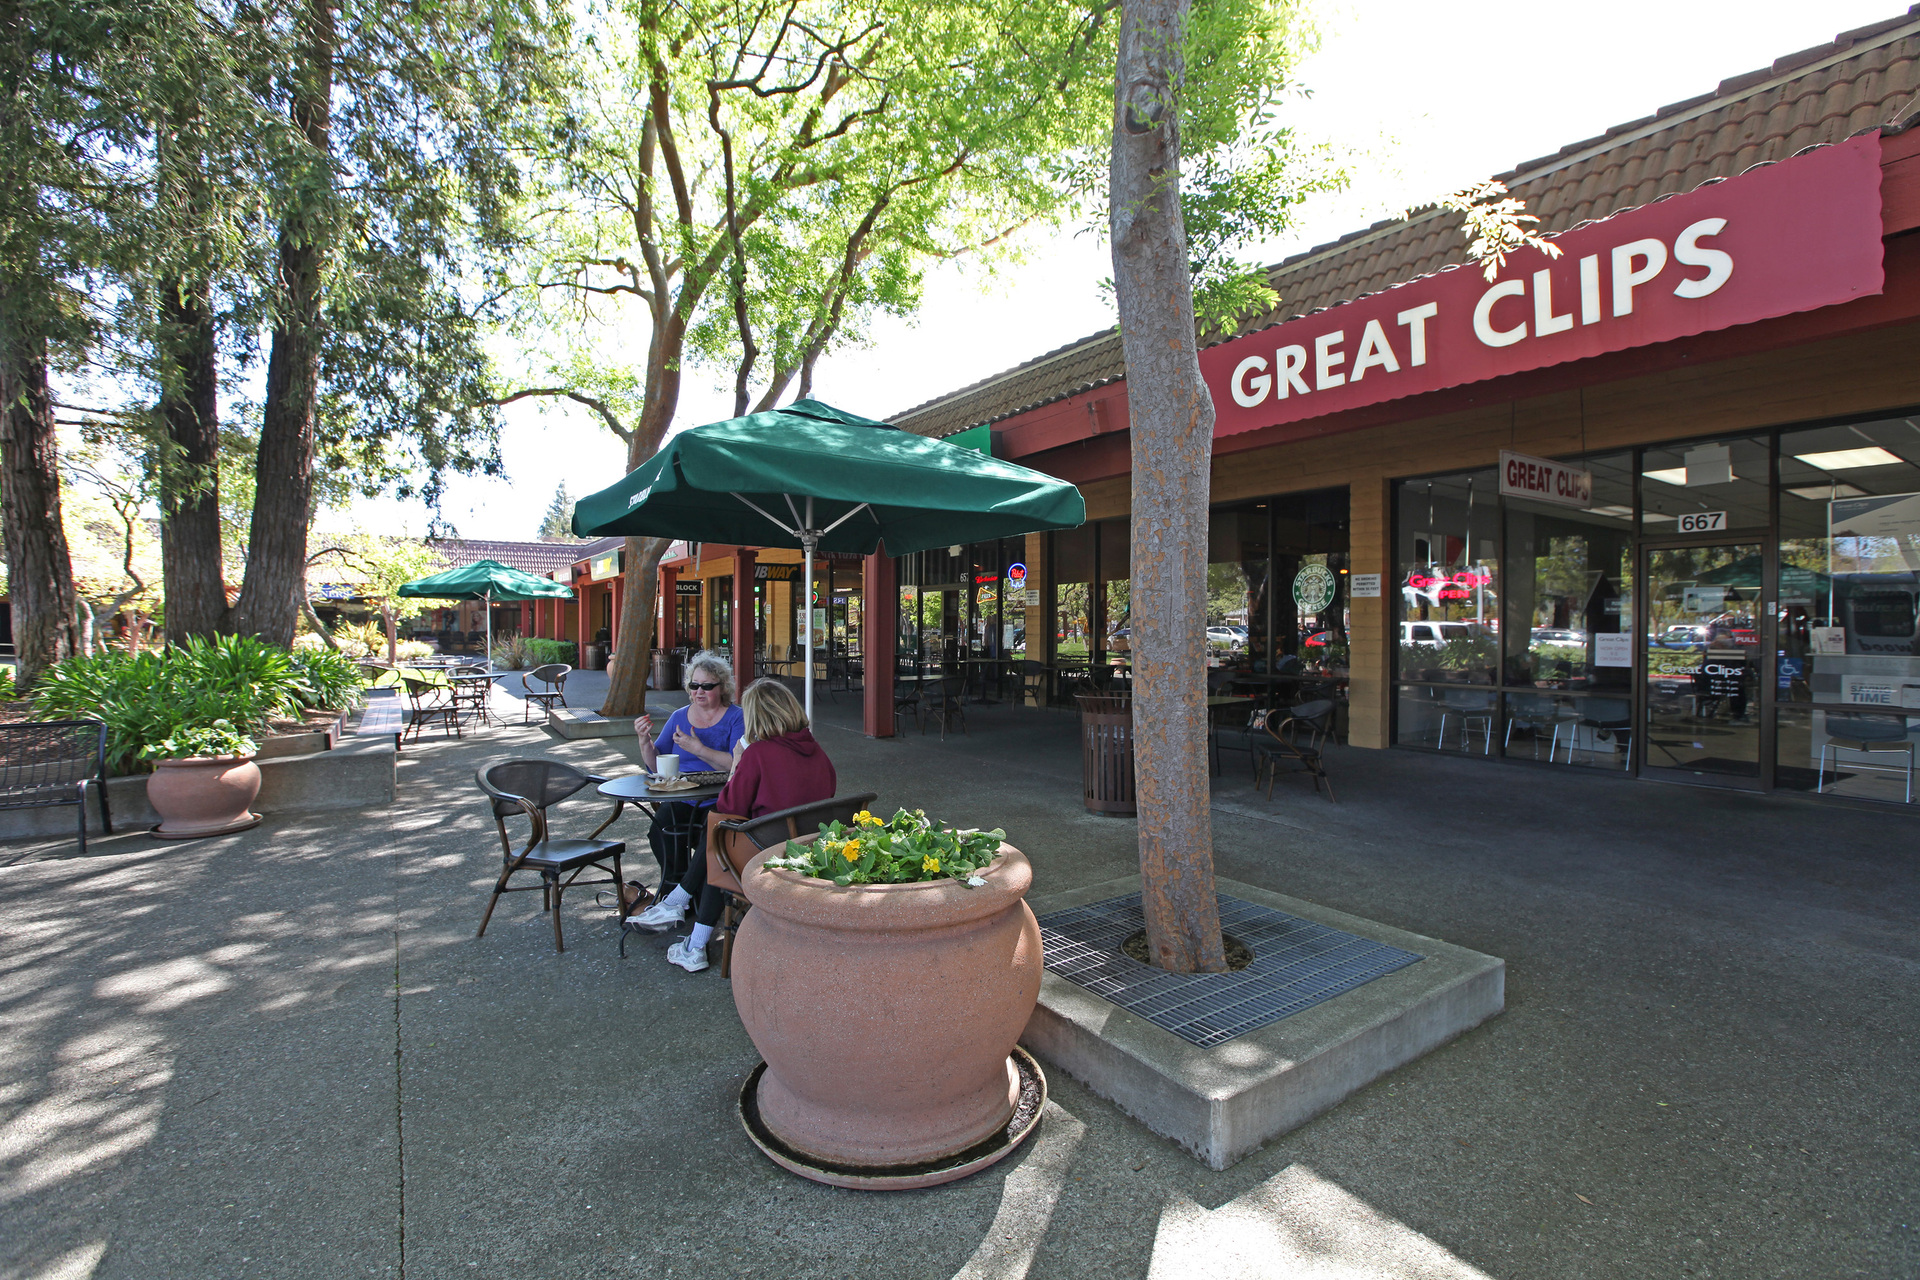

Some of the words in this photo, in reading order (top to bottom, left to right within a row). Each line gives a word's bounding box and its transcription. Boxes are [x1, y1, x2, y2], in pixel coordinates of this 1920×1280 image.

[1230, 302, 1438, 408] GREAT
[1473, 217, 1735, 348] CLIPS
[1507, 458, 1553, 493] GREAT
[1556, 470, 1590, 501] CLIPS
[1681, 512, 1723, 531] 667
[754, 565, 798, 579] UBWAY
[1295, 566, 1334, 587] STARBUCKS
[1434, 589, 1470, 599] PEN
[1298, 598, 1328, 611] COFFEE
[1660, 662, 1702, 675] Great
[1705, 664, 1742, 678] Clips
[1850, 685, 1892, 693] SAVING
[1850, 693, 1891, 703] TIME
